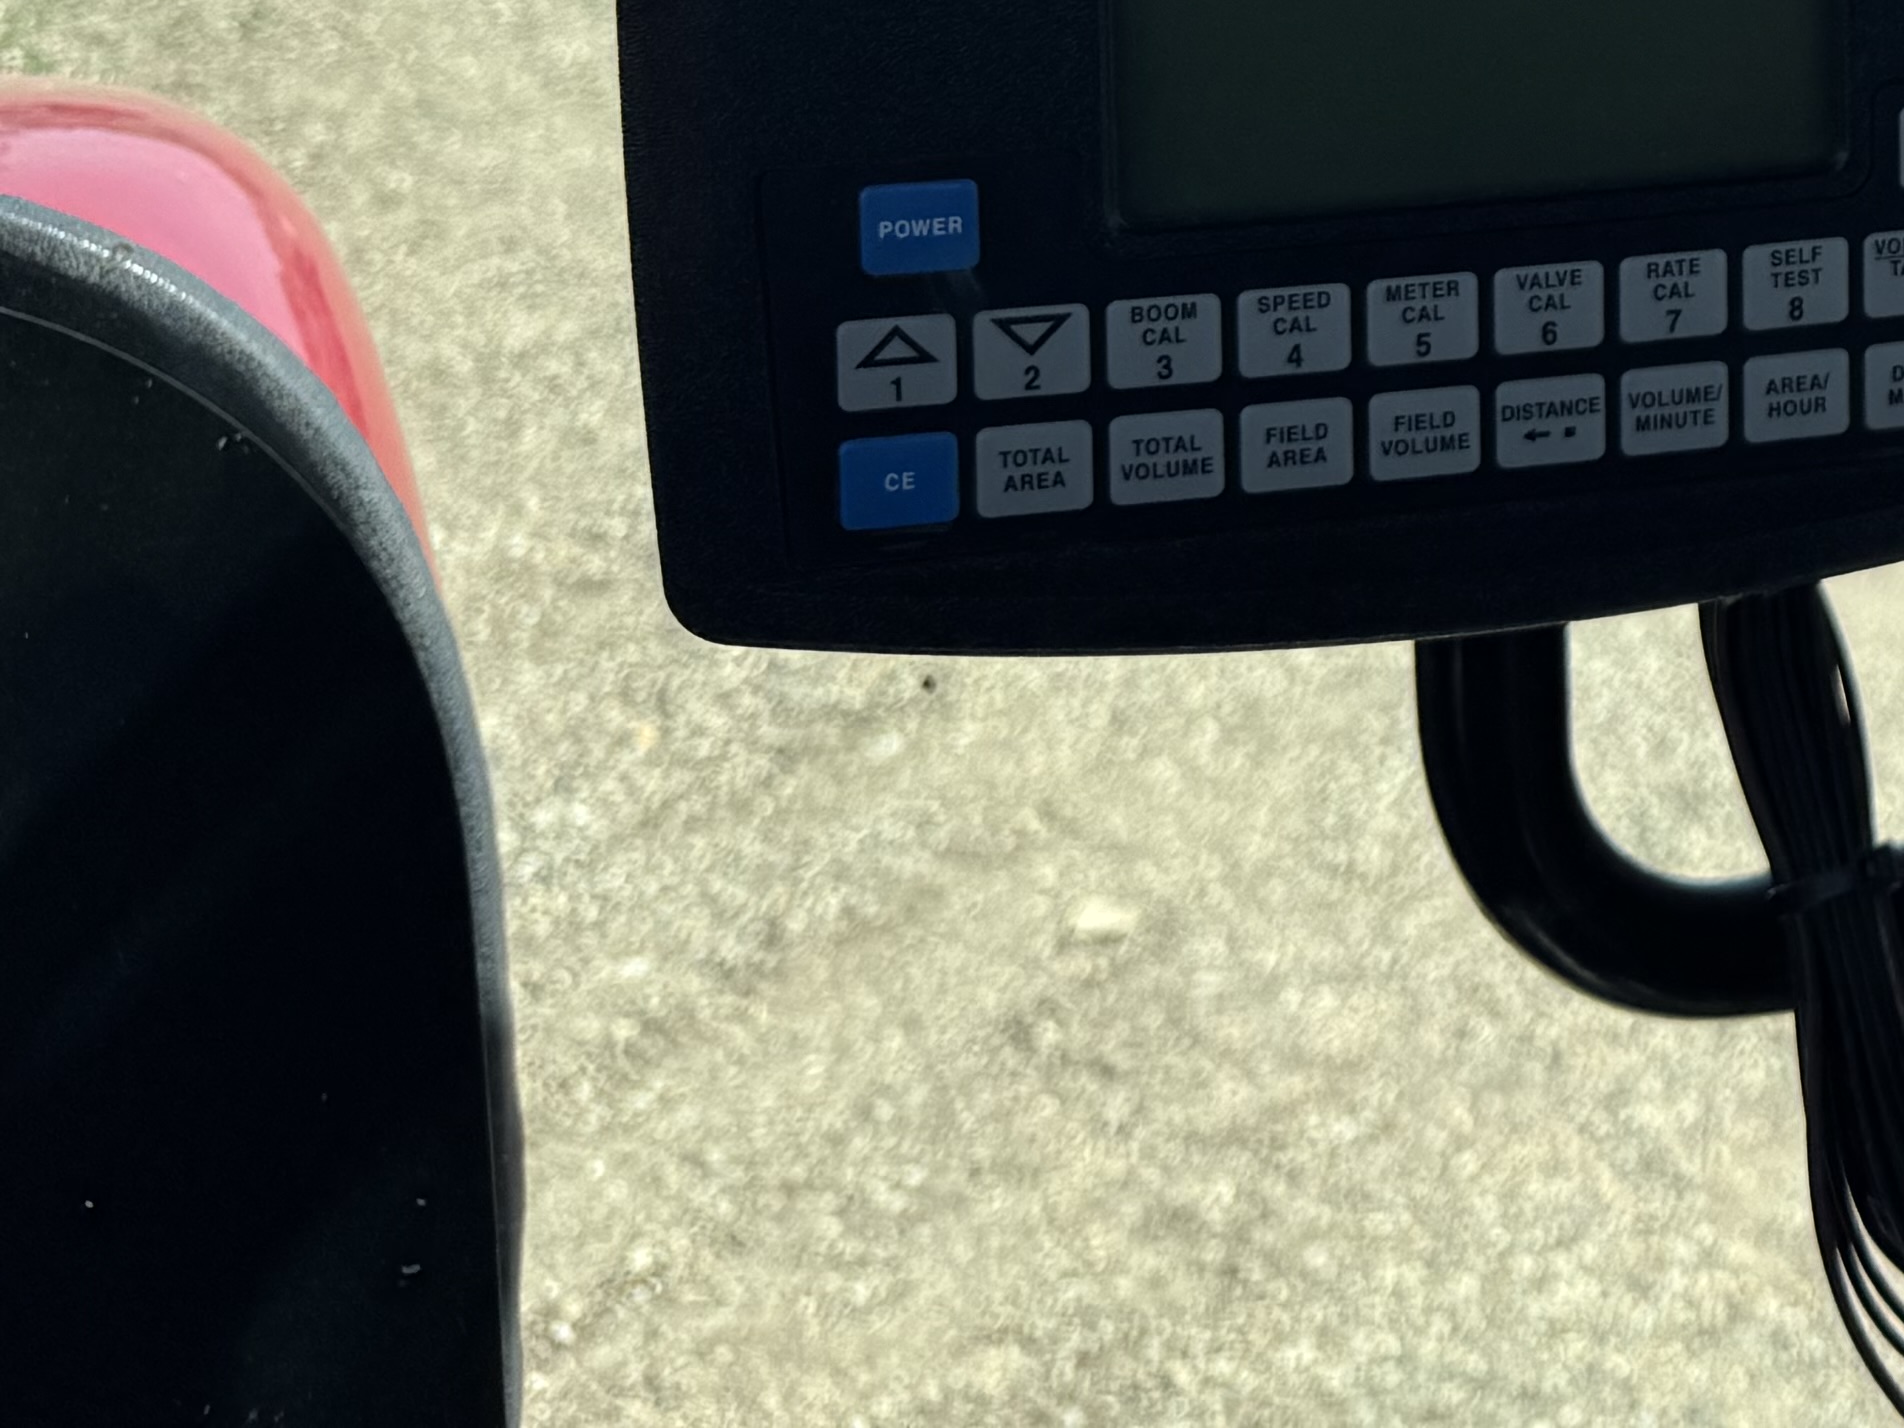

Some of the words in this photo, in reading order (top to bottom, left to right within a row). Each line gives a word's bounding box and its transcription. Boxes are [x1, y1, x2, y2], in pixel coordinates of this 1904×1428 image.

[879, 216, 963, 239] POWER
[1770, 245, 1823, 268] SELF
[1515, 268, 1583, 291] VALVE
[1646, 257, 1701, 280] RATE
[1771, 268, 1823, 289] TEST
[1257, 290, 1331, 314] SPEED
[1385, 279, 1460, 303] METER
[1652, 280, 1696, 302] CAL
[1130, 301, 1198, 324] BOOM
[1401, 304, 1446, 324] CAL
[1528, 293, 1571, 313] CAL
[1788, 296, 1804, 321] 8
[1273, 315, 1318, 336] CAL
[1665, 308, 1682, 334] 7
[1142, 326, 1187, 346] CAL
[1415, 332, 1432, 357] 5
[1541, 321, 1558, 346] 6
[1156, 354, 1174, 381] 3
[1287, 344, 1304, 369] 4
[890, 377, 902, 402] 1
[1024, 365, 1041, 391] 2
[1765, 372, 1829, 396] AREA/
[1629, 383, 1723, 411] VOLUME/
[1767, 397, 1827, 419] HOUR
[1394, 410, 1456, 432] FIELD
[1501, 396, 1601, 423] DISTANCE
[1635, 407, 1715, 433] MINUTE
[1265, 422, 1329, 444] FIELD
[1380, 432, 1471, 457] VOLUME
[998, 446, 1070, 469] TOTAL
[1132, 435, 1203, 457] TOTAL
[1120, 457, 1214, 481] VOLUME
[1267, 447, 1328, 469] AREA
[884, 472, 916, 491] CE
[1003, 470, 1066, 493] AREA
